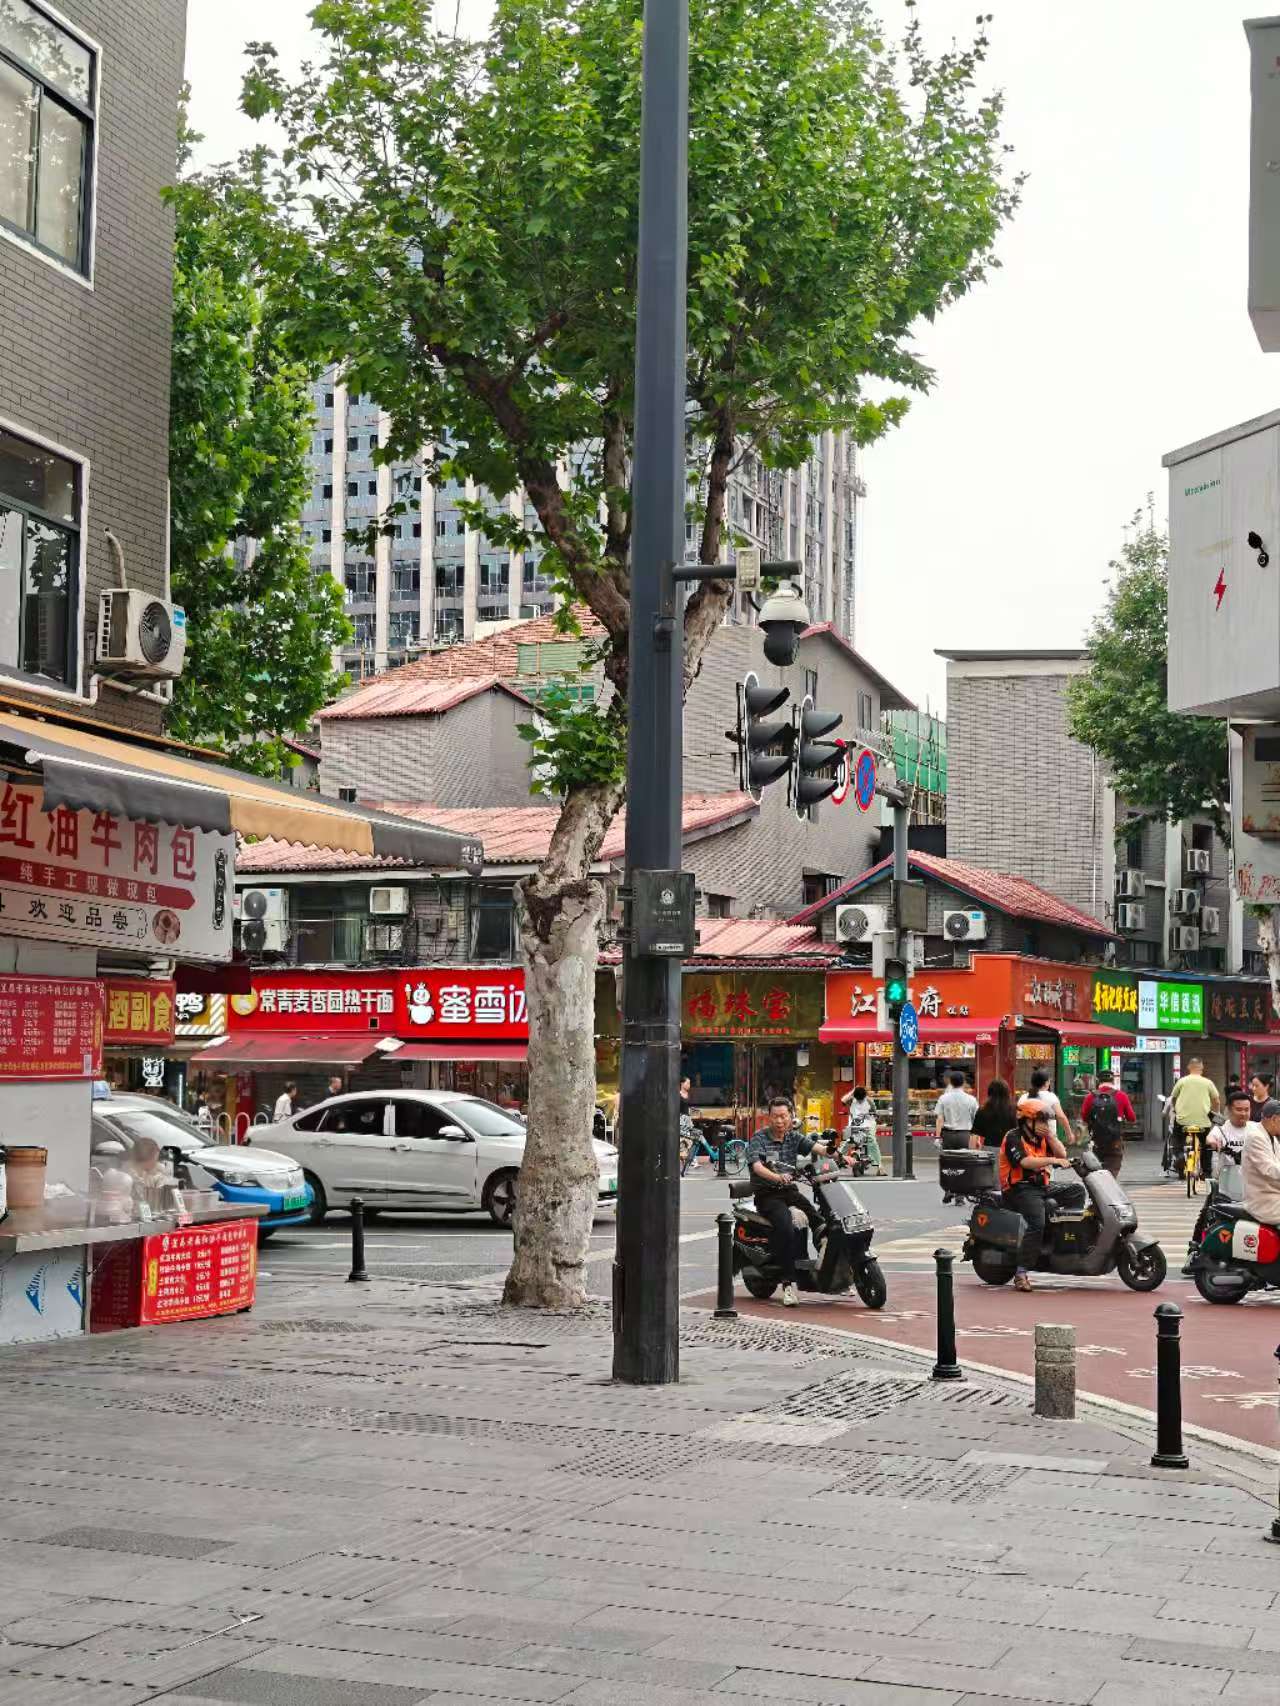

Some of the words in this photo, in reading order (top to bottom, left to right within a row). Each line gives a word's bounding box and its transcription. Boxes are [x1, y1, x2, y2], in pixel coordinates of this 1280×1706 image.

[0, 784, 197, 881] 红油牛肉包
[19, 863, 158, 904] 纯手工现做现包
[28, 898, 130, 932] 欢迎品尝
[108, 990, 172, 1032] 酒副食
[259, 988, 395, 1015] 常青麦香园热干面
[850, 985, 942, 1018] 江府
